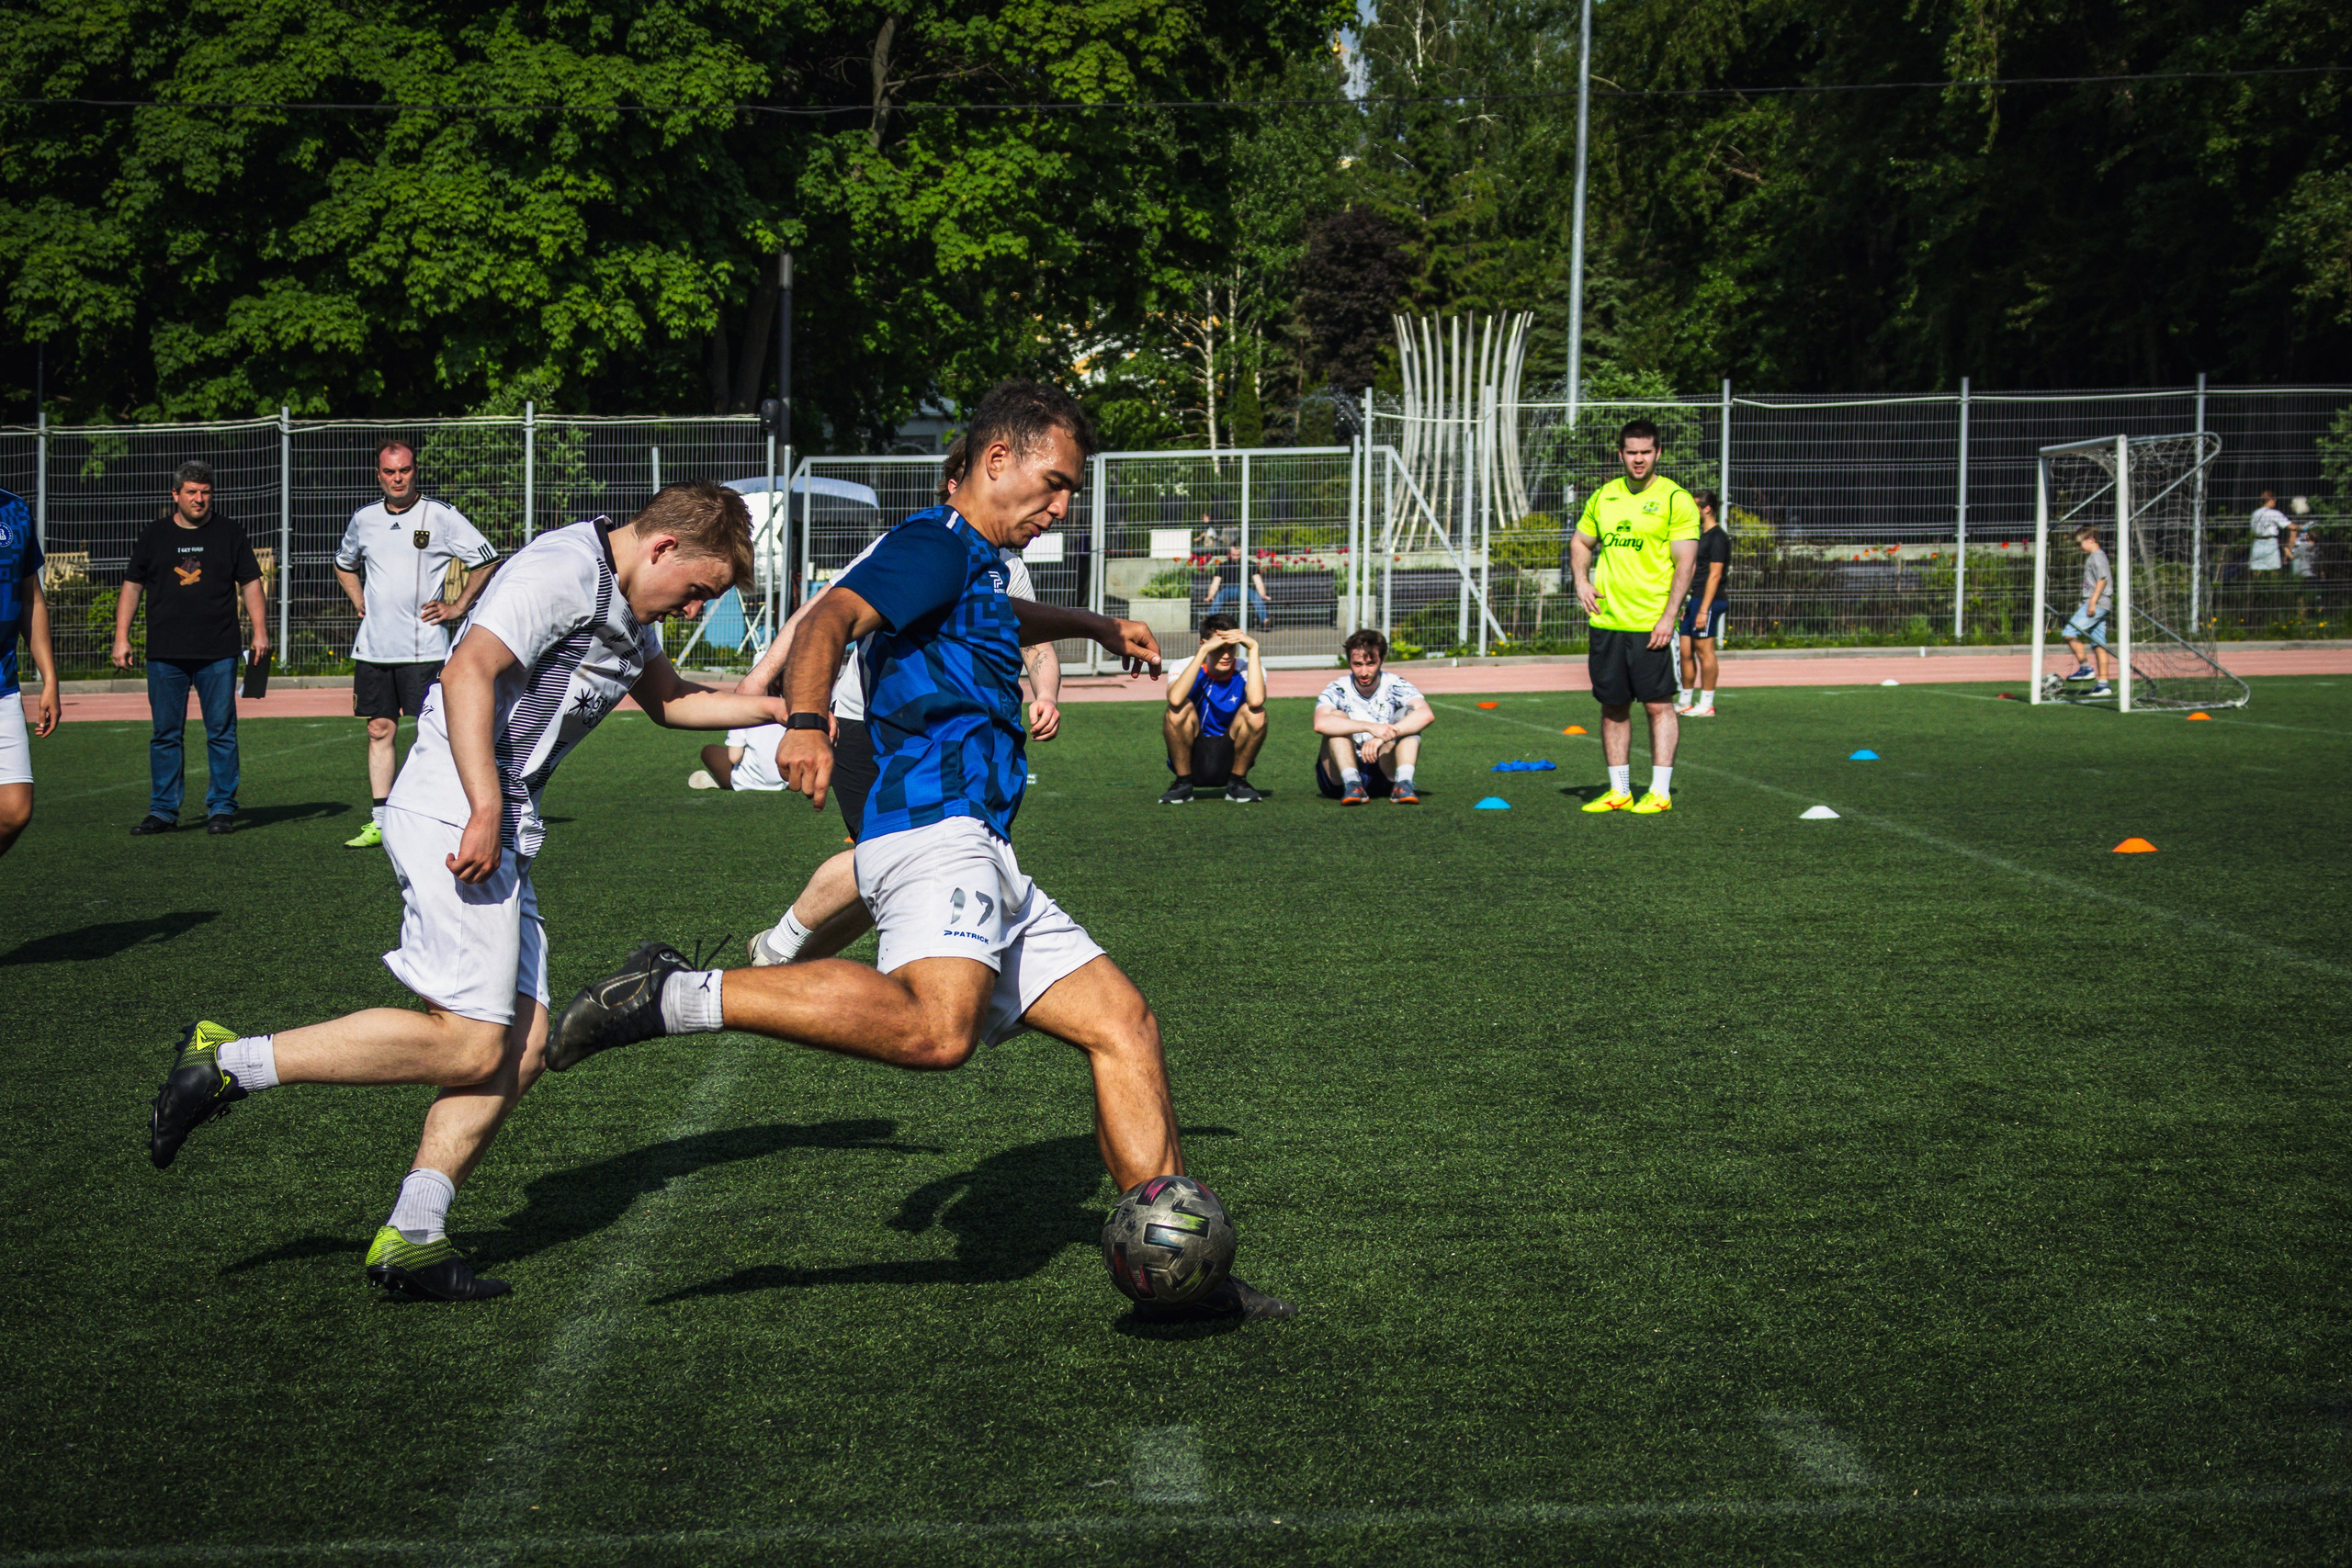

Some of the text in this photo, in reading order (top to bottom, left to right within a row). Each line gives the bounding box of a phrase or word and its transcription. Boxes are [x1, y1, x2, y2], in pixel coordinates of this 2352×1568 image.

[1602, 532, 1644, 551] Chang
[949, 886, 995, 927] 17
[953, 931, 989, 945] PATRICK
